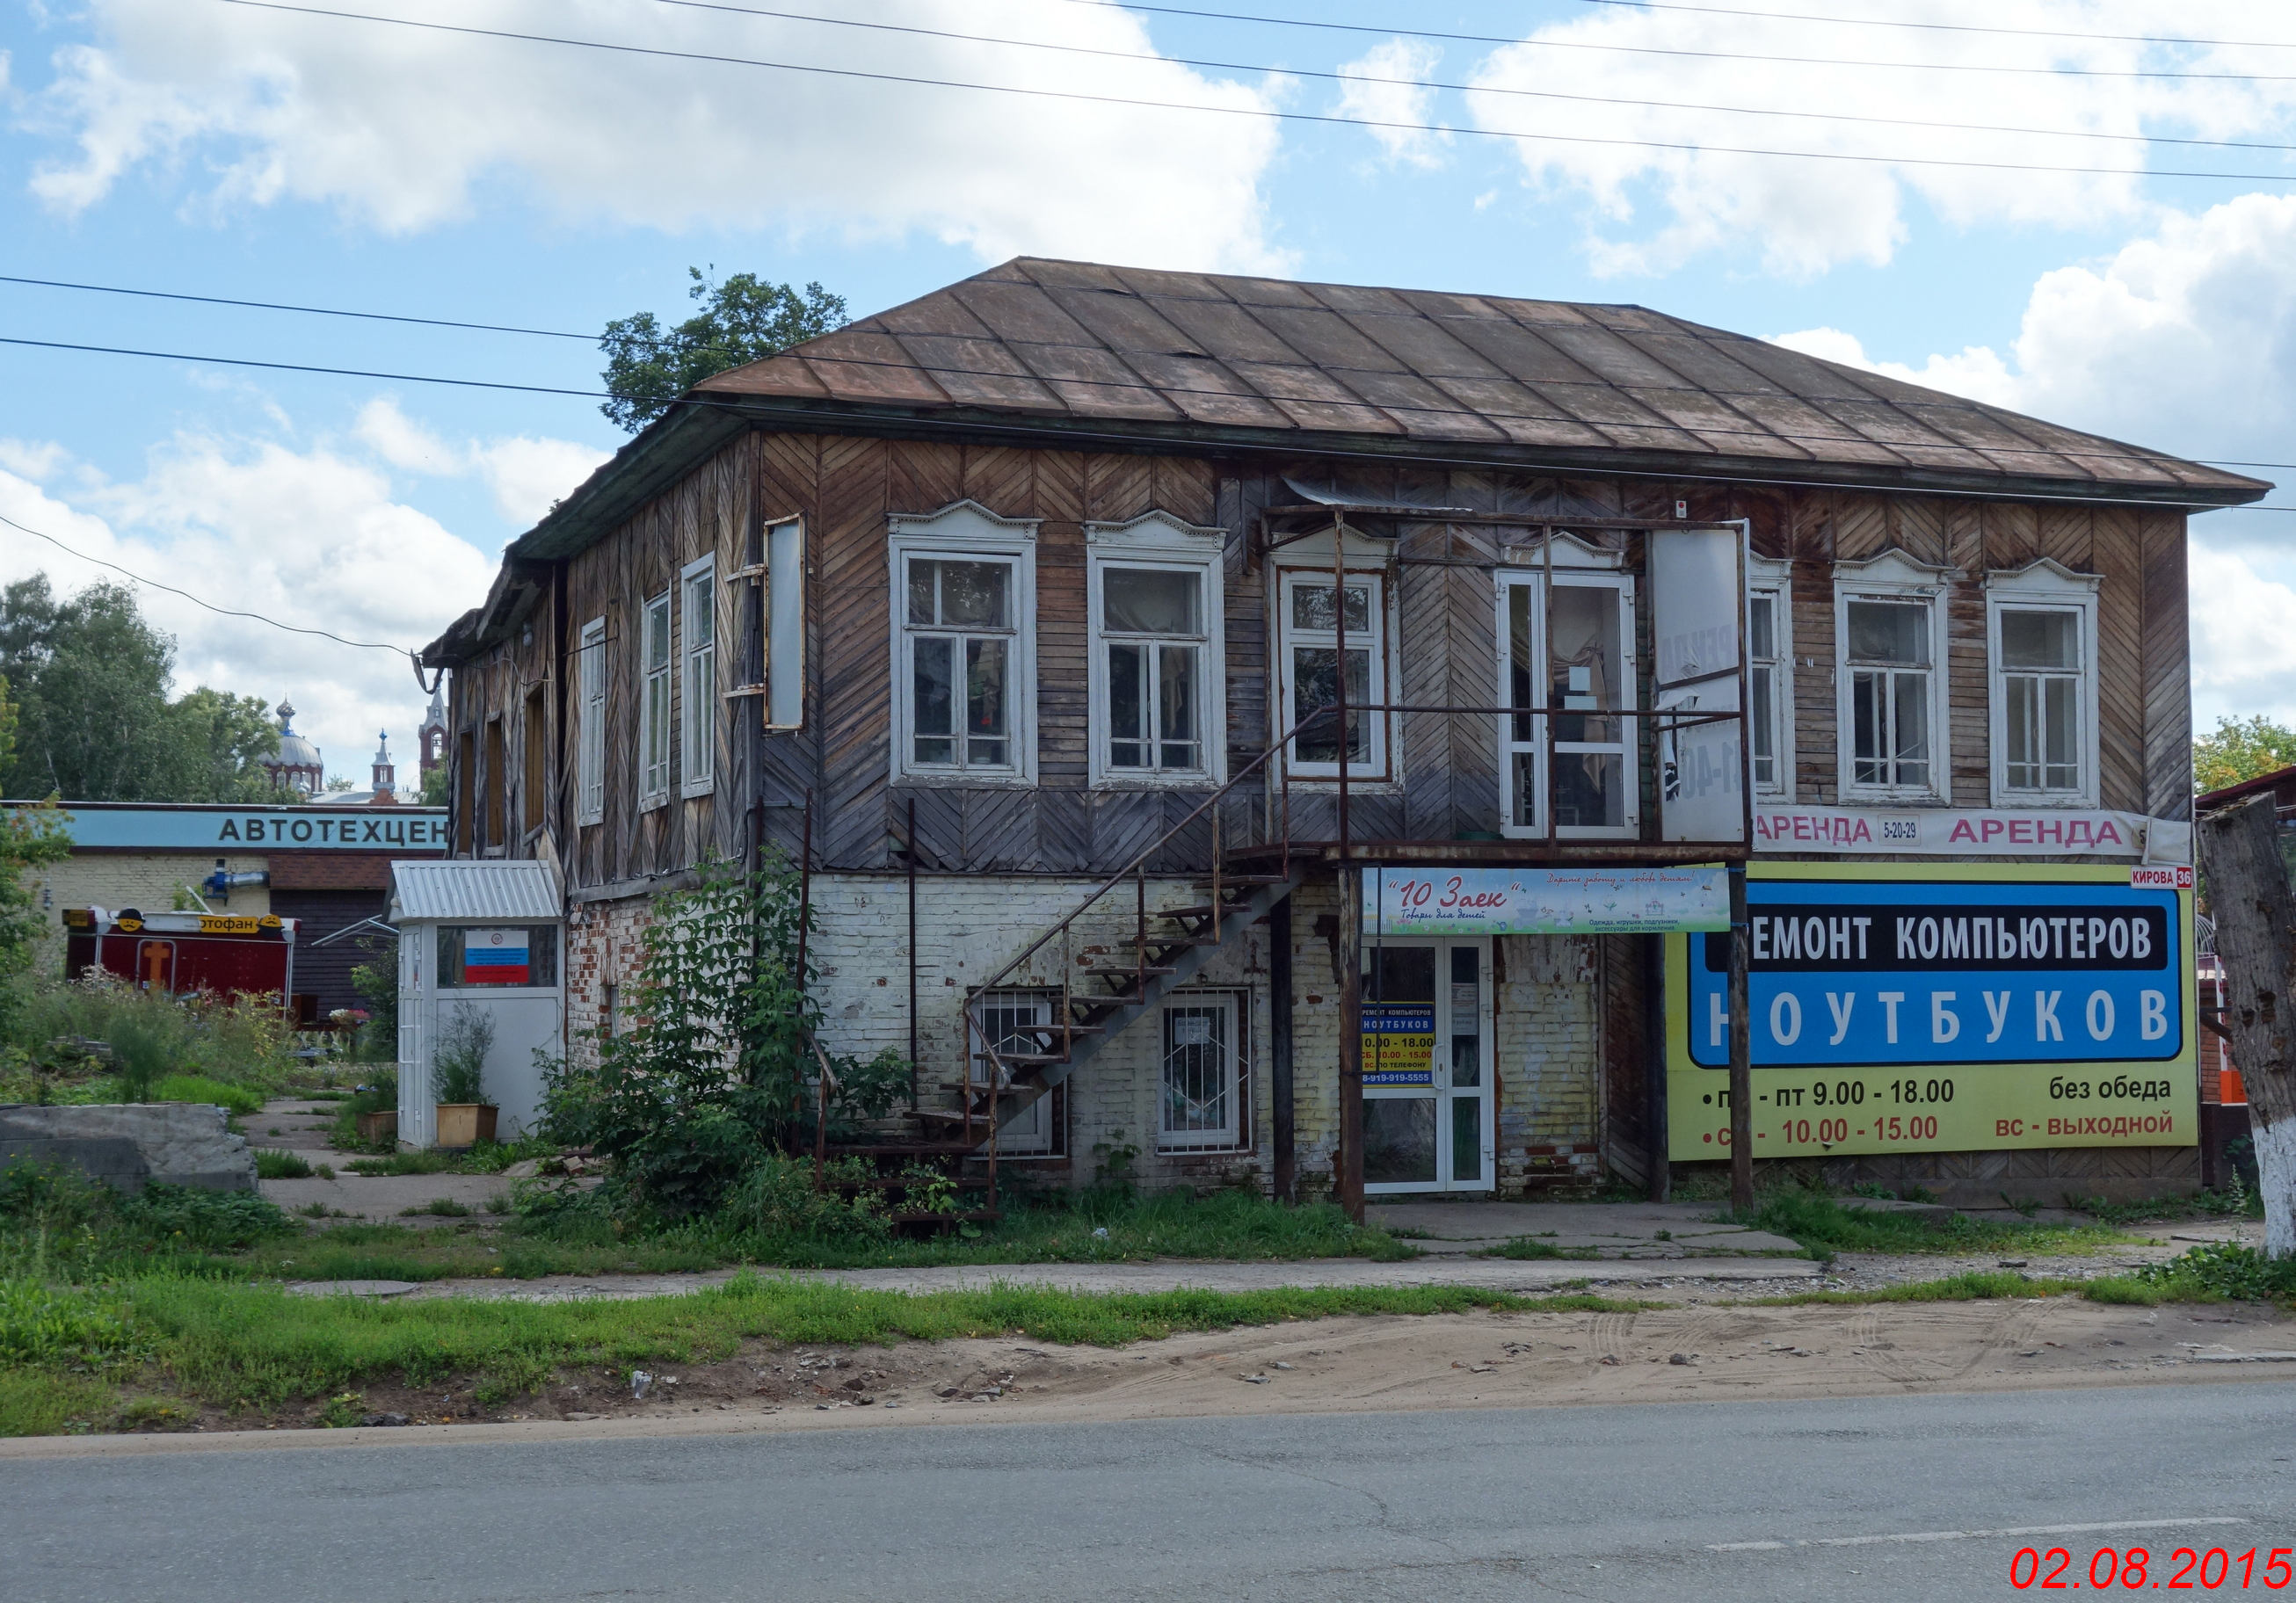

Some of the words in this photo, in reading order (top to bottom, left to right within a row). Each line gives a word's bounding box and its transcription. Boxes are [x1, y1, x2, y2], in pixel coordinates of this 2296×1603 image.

[219, 818, 449, 846] АВТОТЕХЦЕН
[1757, 816, 1872, 846] АРЕНДА
[1884, 822, 1916, 838] 5-20-29
[1949, 819, 2123, 848] АРЕНДА
[2133, 871, 2174, 884] КИРОВА
[2177, 871, 2191, 884] 36
[1401, 908, 1432, 923] Товары
[1436, 908, 1455, 919] для
[1457, 909, 1486, 919] детей
[1747, 917, 1871, 960] ЕМОНТ
[1896, 917, 2151, 960] КОМПЬЮТЕРОВ
[1363, 1020, 1428, 1029] НОУТБУКОВ
[1402, 1038, 1434, 1048] 18.00
[1362, 1073, 1429, 1082] 8-919-919-5555
[2050, 1076, 2090, 1099] без
[2098, 1075, 2171, 1101] обеда
[1718, 1091, 1731, 1107] п
[1776, 1089, 1806, 1106] пт
[1813, 1081, 1864, 1106] 9.00
[1891, 1079, 1954, 1104] 18.00
[1718, 1128, 1732, 1146] с
[1783, 1118, 1847, 1143] 10.00
[1874, 1116, 1937, 1140] 15.00
[2047, 1109, 2173, 1137] выходной
